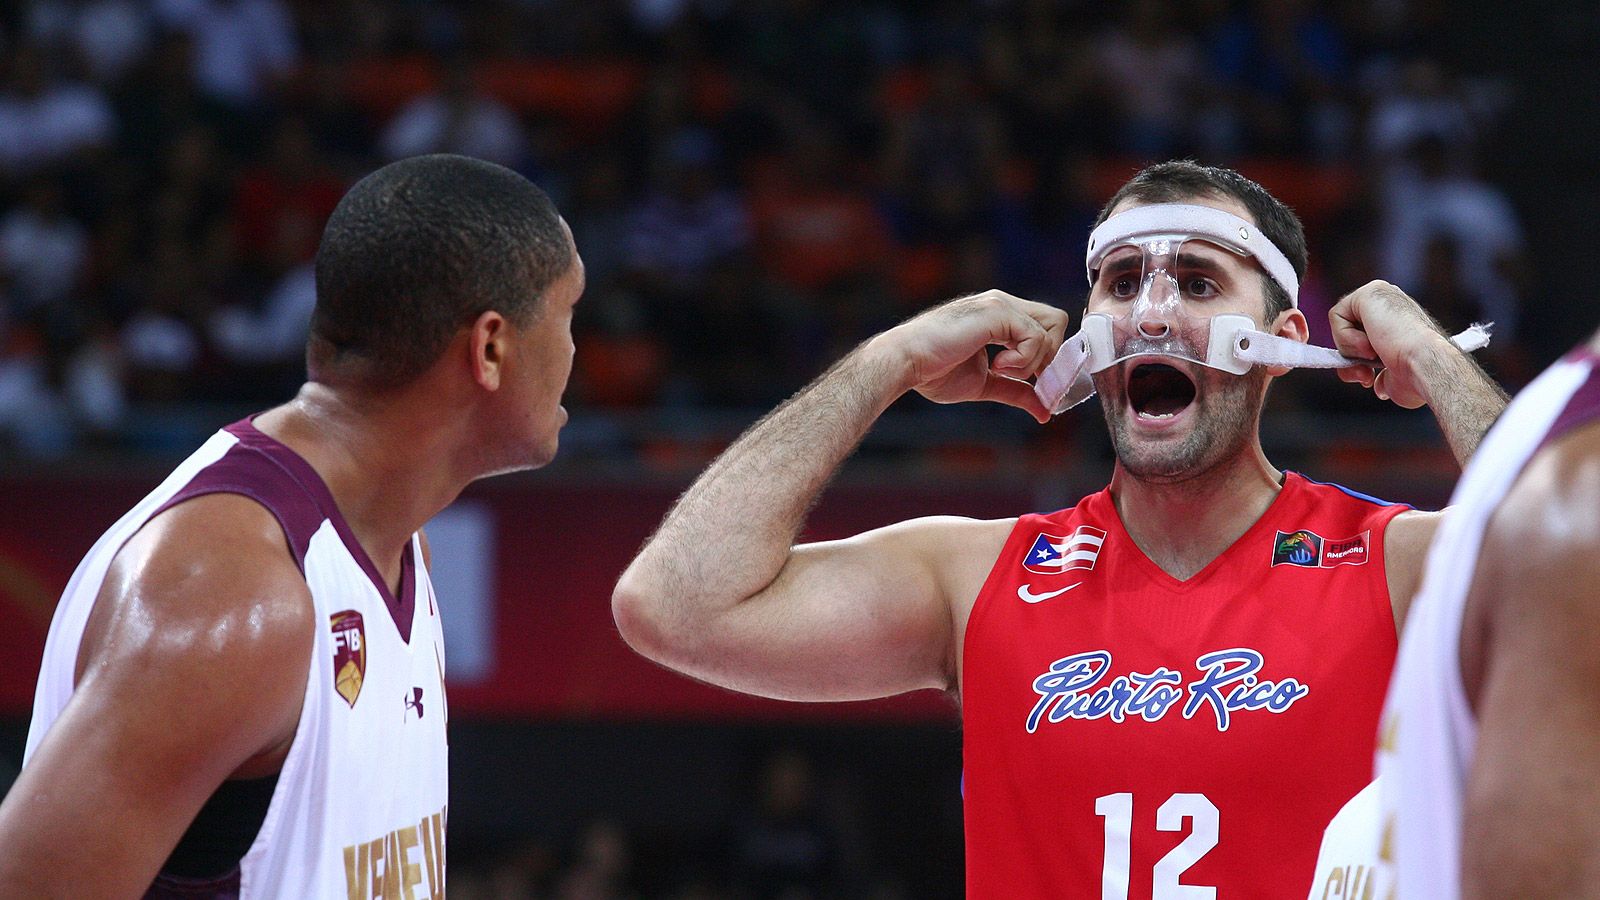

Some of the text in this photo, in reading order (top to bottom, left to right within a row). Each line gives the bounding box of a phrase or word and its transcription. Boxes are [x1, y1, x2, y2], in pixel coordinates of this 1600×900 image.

[331, 628, 361, 658] FVB
[1026, 648, 1309, 733] Puerto Rico
[1095, 792, 1220, 900] 12
